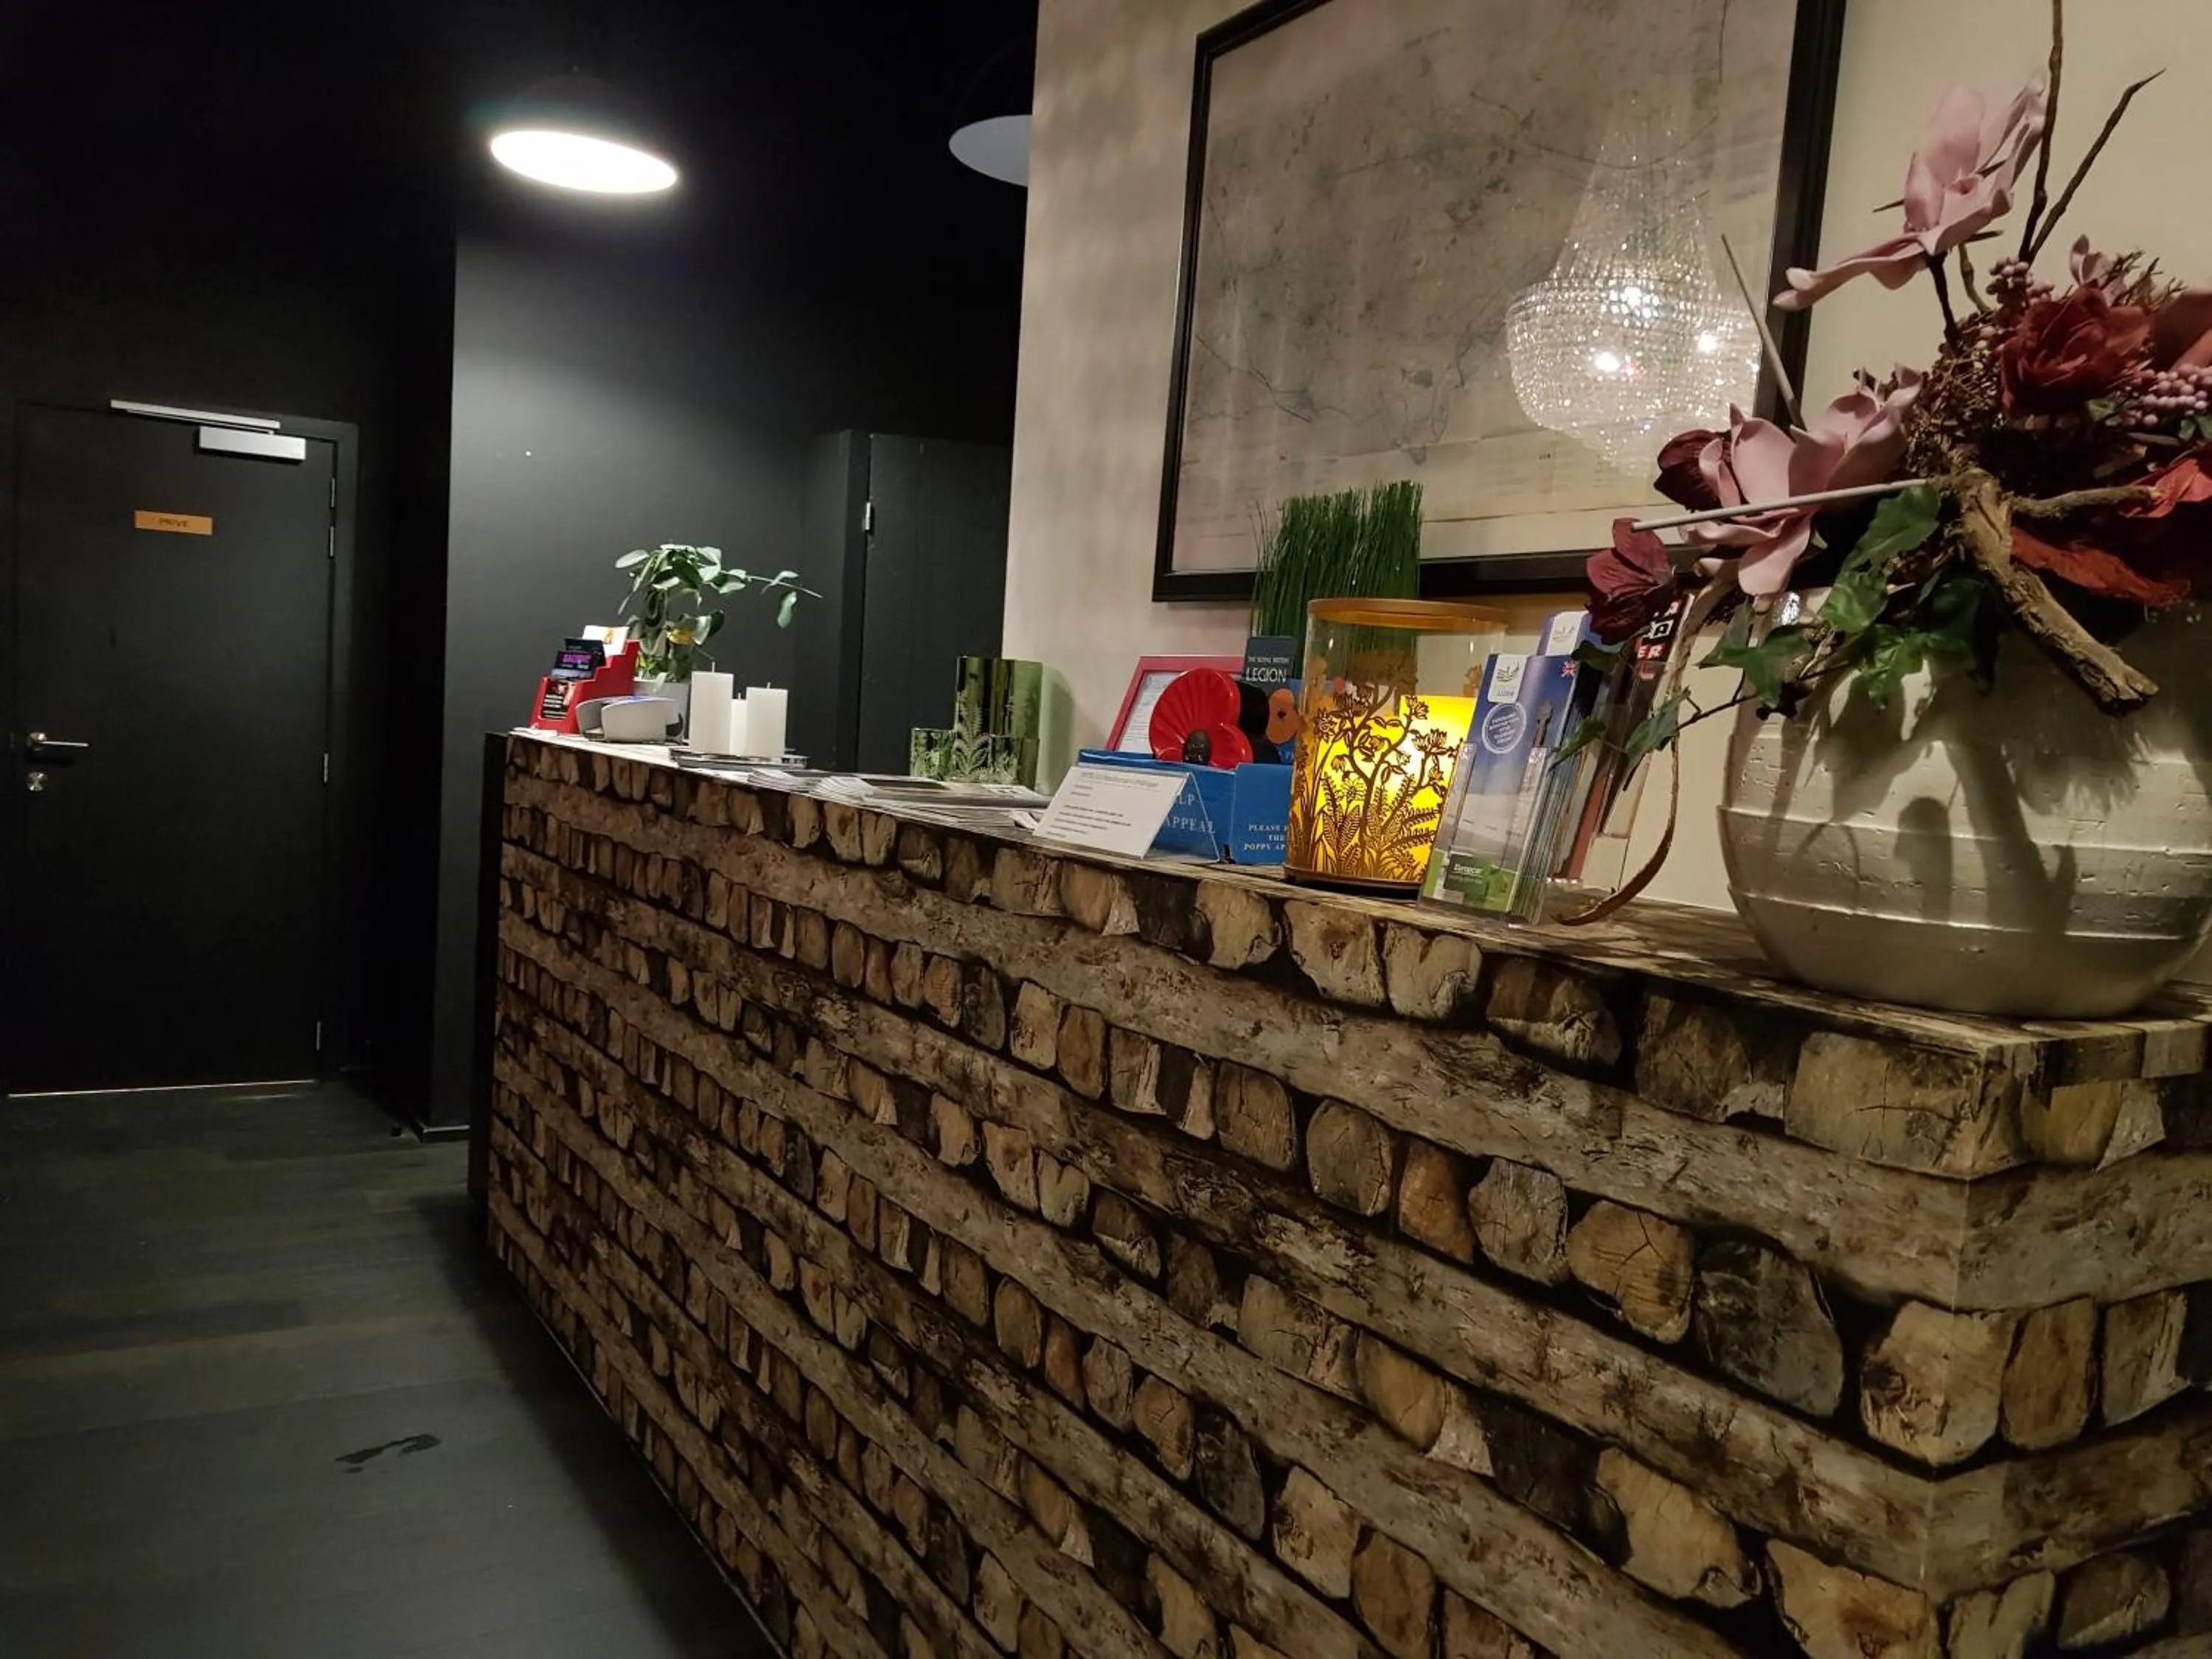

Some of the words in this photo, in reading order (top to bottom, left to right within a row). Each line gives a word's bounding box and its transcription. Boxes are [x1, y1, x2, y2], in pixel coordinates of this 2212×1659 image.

[1245, 666, 1287, 684] LEGION
[1166, 816, 1216, 834] APPEAL
[1248, 824, 1281, 832] PLEASE
[1244, 842, 1270, 850] POPPY
